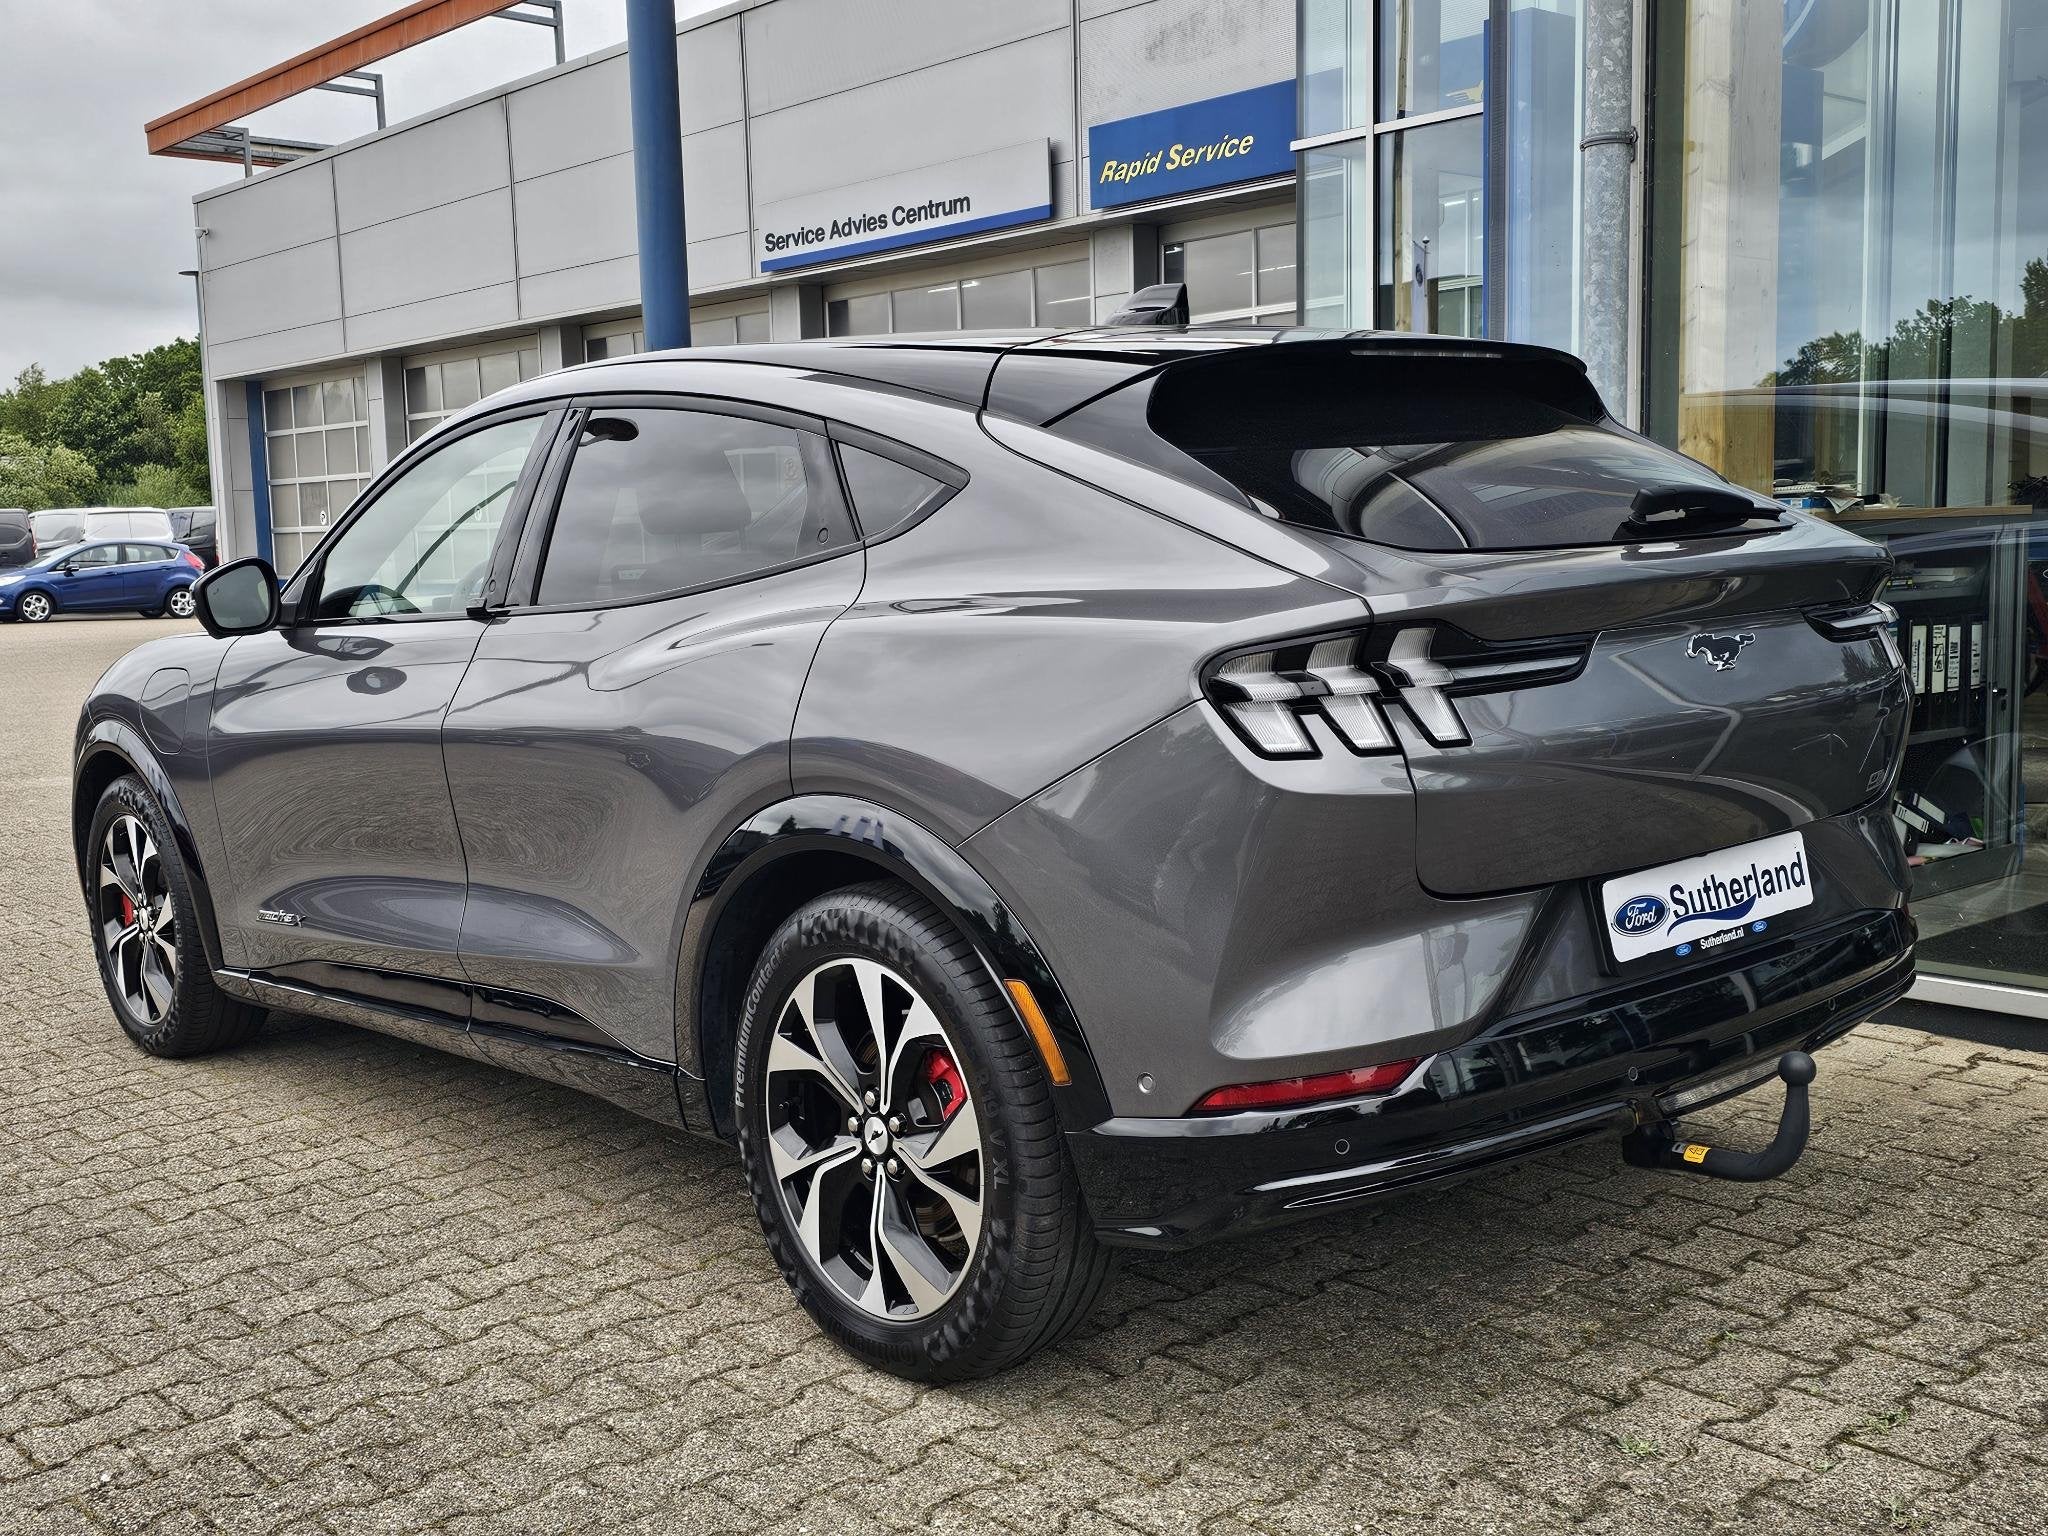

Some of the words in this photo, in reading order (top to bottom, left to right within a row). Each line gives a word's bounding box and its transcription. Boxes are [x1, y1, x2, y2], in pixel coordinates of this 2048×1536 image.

[1100, 150, 1163, 184] Rapid
[1165, 134, 1254, 171] Service
[764, 227, 825, 252] Service
[829, 213, 888, 240] Advies
[892, 195, 970, 226] Centrum
[1625, 902, 1657, 929] Ford
[1669, 852, 1806, 919] Sutherland
[1700, 927, 1745, 949] Sutherland.nl
[735, 947, 782, 1109] PremiumContact
